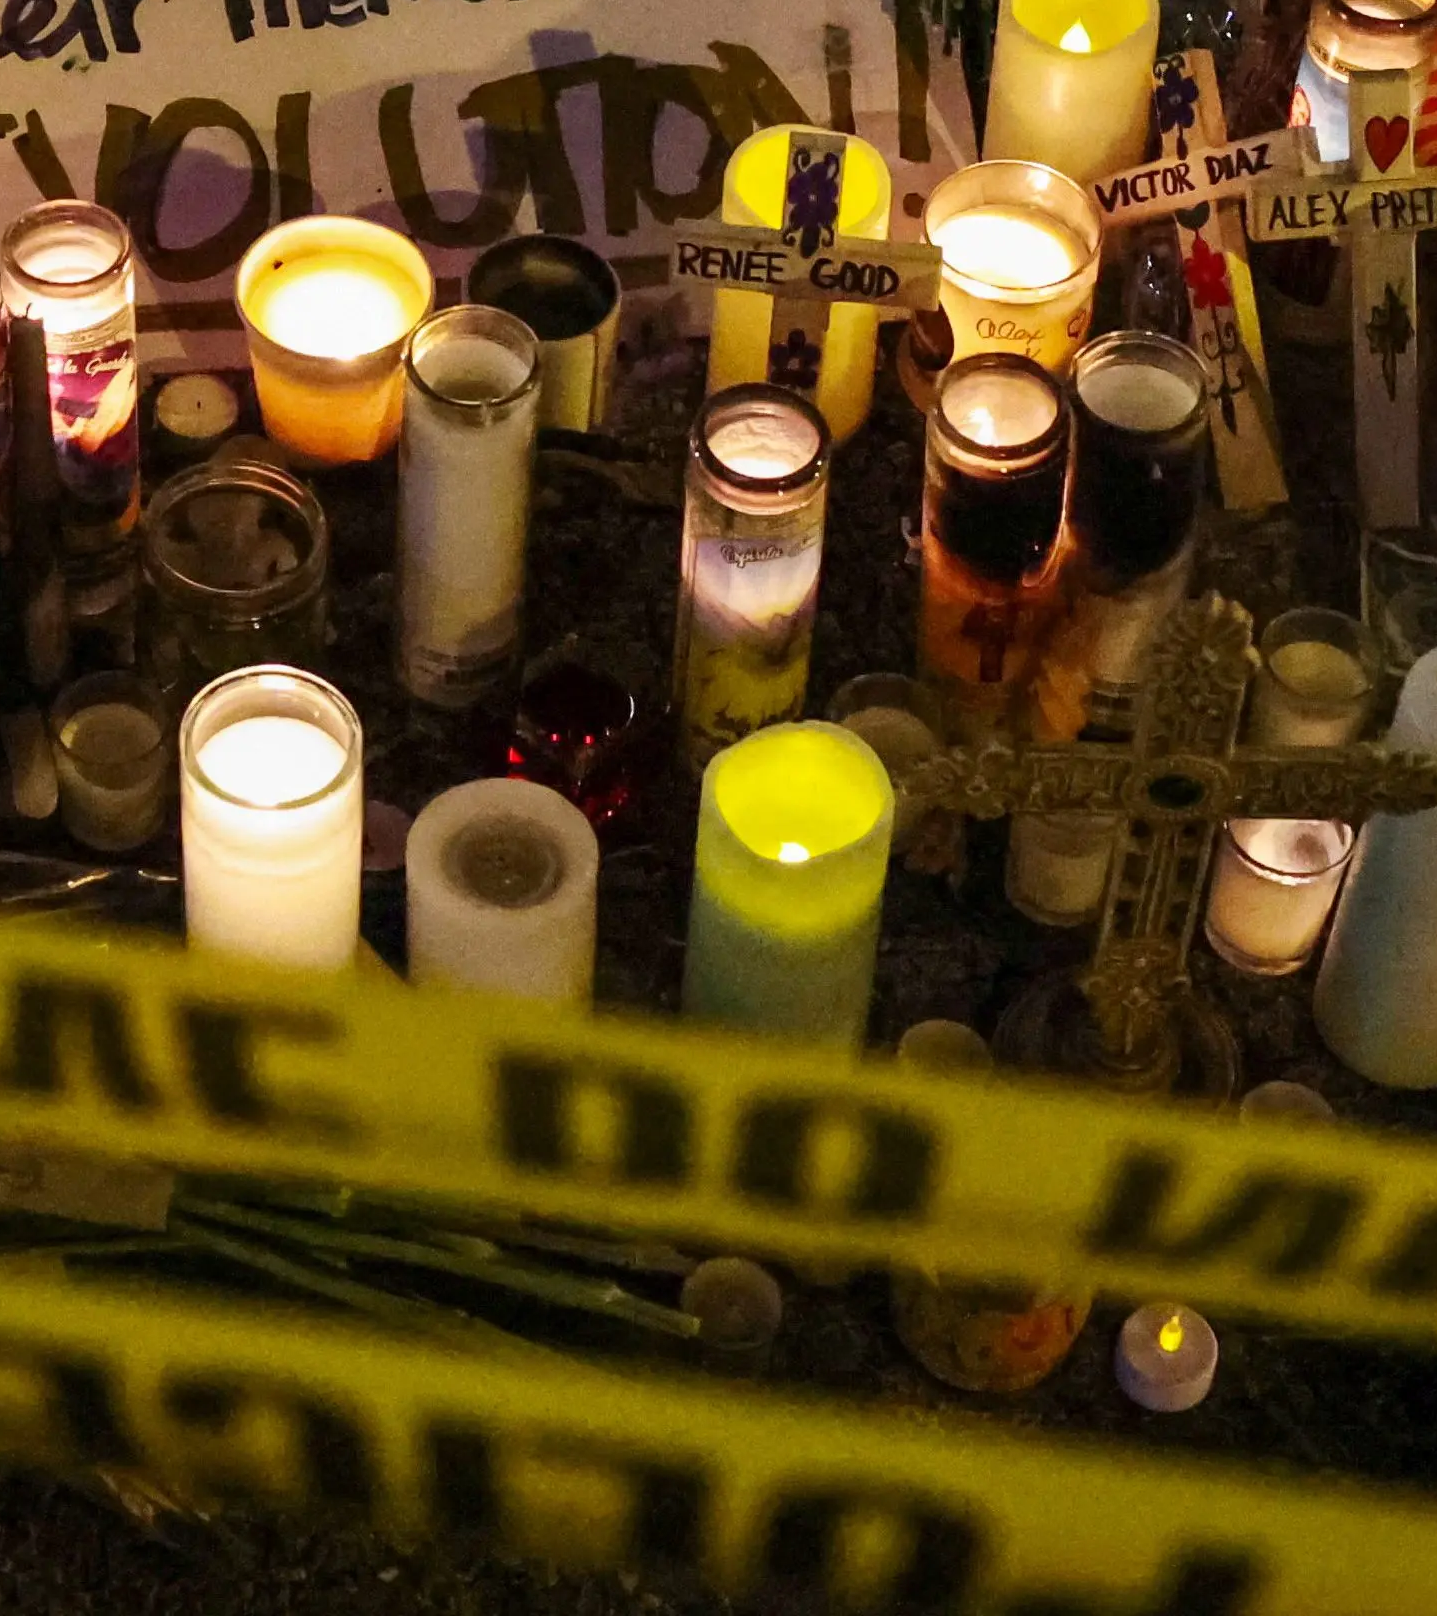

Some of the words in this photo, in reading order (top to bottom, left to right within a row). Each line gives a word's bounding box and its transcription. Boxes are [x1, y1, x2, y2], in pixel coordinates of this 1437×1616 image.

[1094, 158, 1193, 215] VICTOR
[1203, 142, 1274, 183] DIAZ
[1266, 190, 1349, 232] ALEX
[675, 239, 787, 286] RENÉE
[809, 254, 901, 299] GOOD
